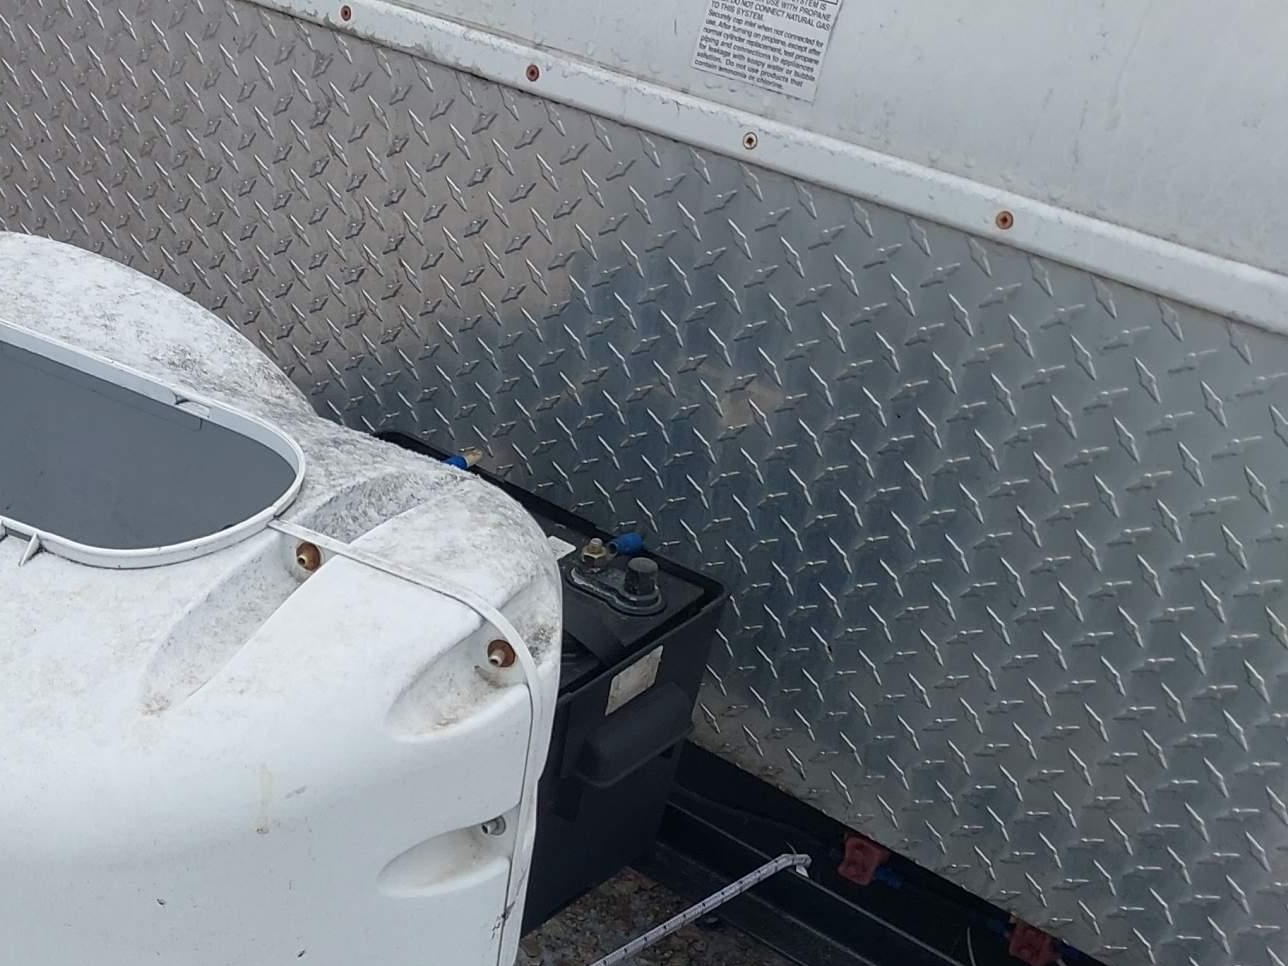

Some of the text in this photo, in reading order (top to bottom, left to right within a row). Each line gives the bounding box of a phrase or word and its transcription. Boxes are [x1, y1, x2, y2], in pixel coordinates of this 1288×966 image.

[720, 2, 735, 12] THIS
[741, 0, 753, 8] NOT
[754, 3, 784, 17] CONNECT
[785, 12, 816, 26] NATURAL
[815, 21, 830, 30] GAS
[781, 1, 798, 11] WITH
[799, 6, 831, 21] PROPANE
[703, 27, 722, 37] normal
[722, 32, 745, 43] cylinder
[794, 53, 819, 65] propane
[756, 23, 773, 34] when
[783, 31, 815, 46] connected
[700, 35, 719, 45] piping
[720, 40, 732, 49] and
[732, 44, 771, 60] connections
[780, 58, 814, 73] appliances
[707, 46, 731, 57] leakage
[746, 57, 765, 67] soapy
[766, 63, 783, 72] water
[793, 70, 816, 82] bubble
[694, 59, 717, 70] contain
[718, 66, 747, 78] ammonia
[760, 69, 789, 82] products
[790, 78, 803, 86] that
